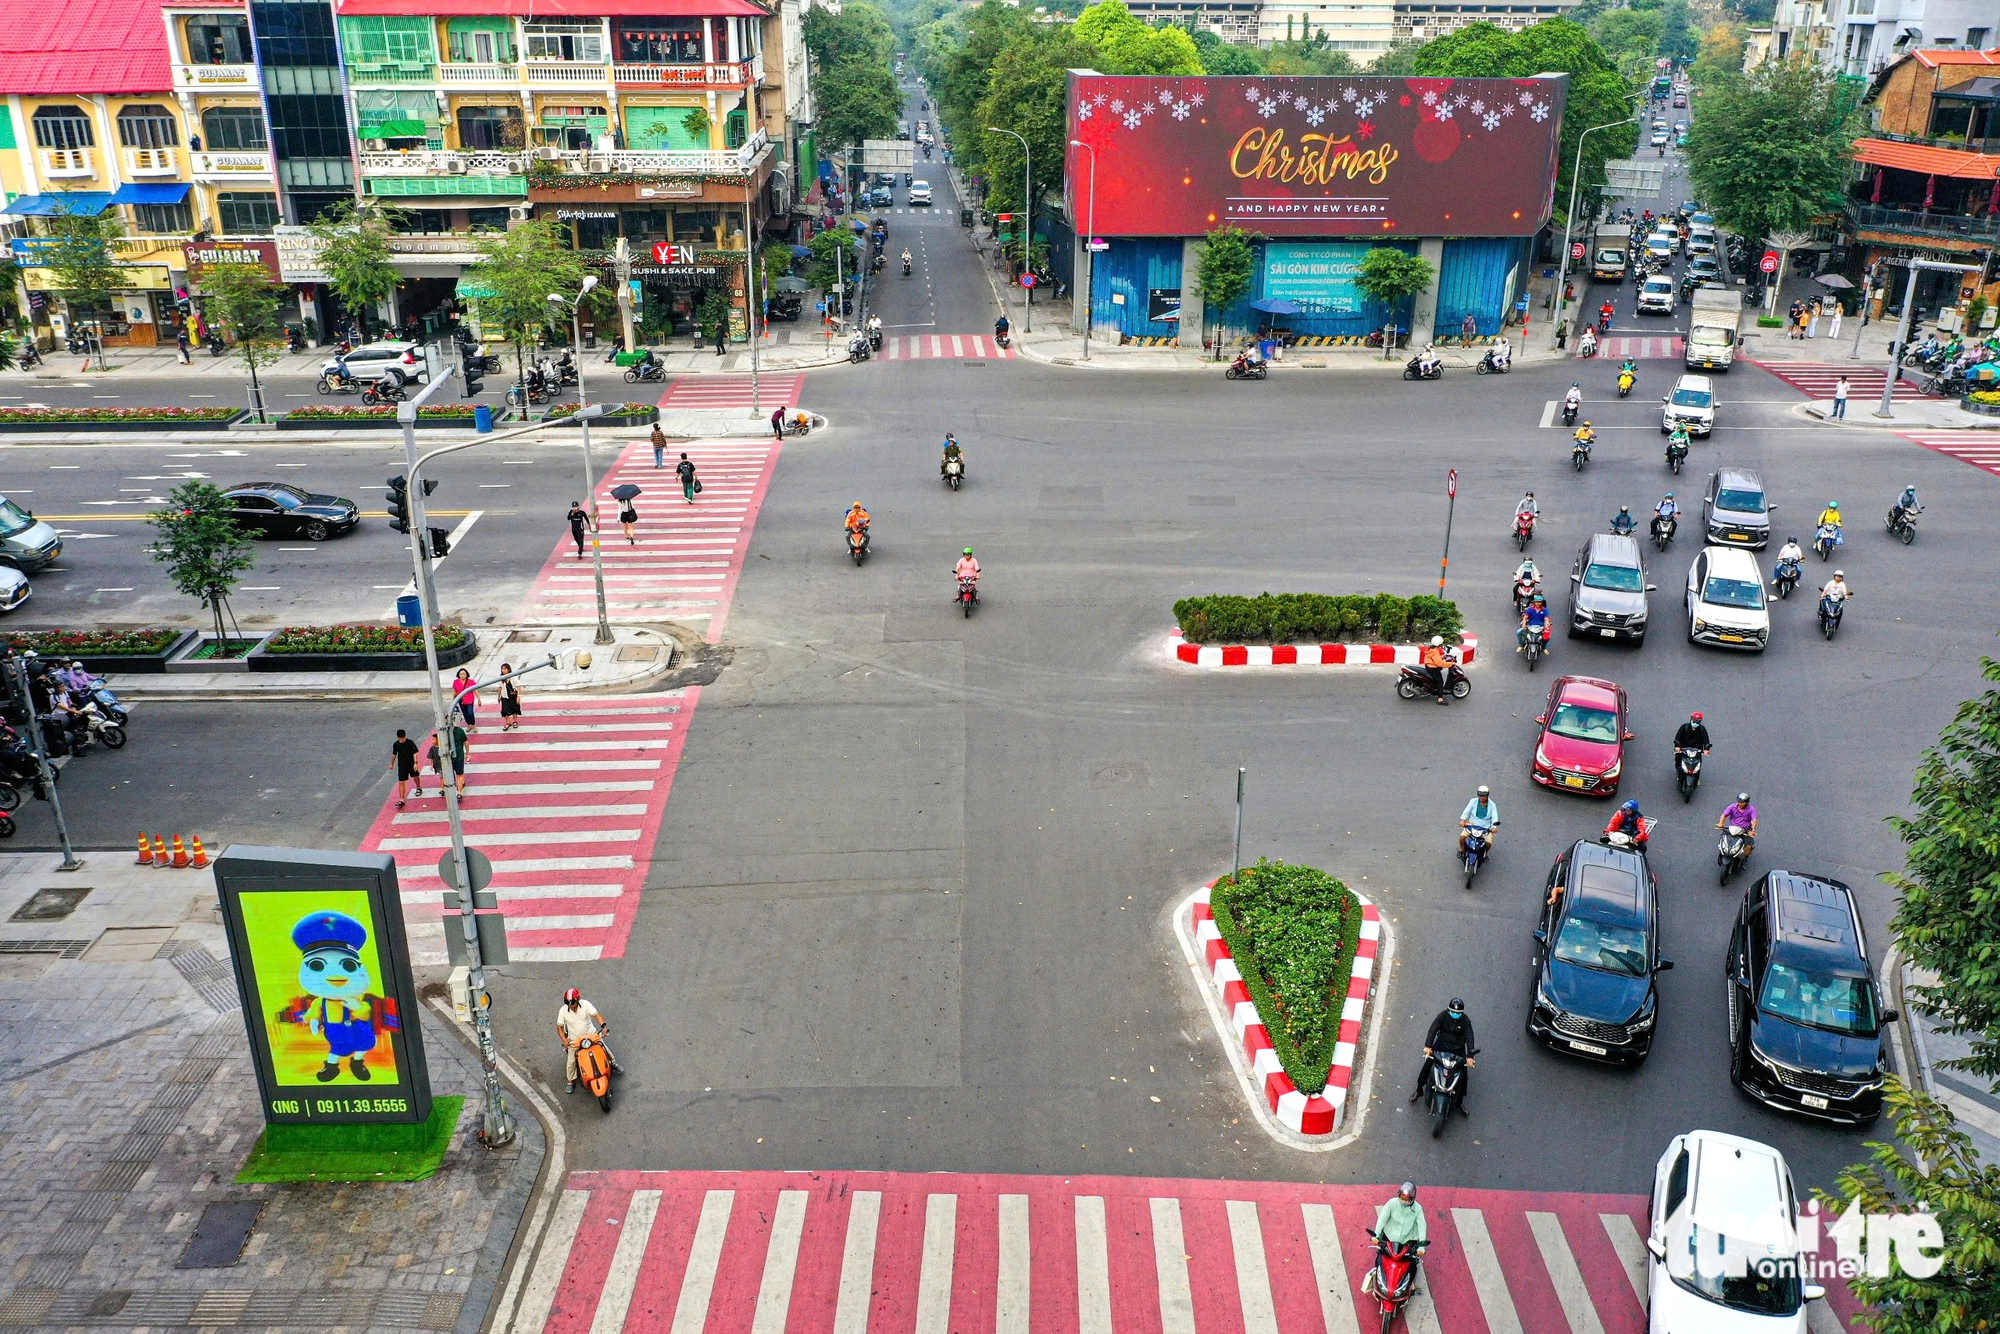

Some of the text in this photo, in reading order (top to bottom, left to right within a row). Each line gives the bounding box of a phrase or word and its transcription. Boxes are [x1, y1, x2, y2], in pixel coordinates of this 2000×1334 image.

[198, 68, 245, 77] GUJARAT
[1230, 127, 1398, 185] Christmas
[216, 157, 263, 166] GUJARAT
[1237, 204, 1377, 213] AND HAPPY NEW YEAR
[278, 239, 308, 250] KING
[199, 249, 261, 264] GUJARAT
[668, 267, 694, 275] SAKE
[696, 267, 716, 275] PUB
[1287, 261, 1309, 275] GÒN
[1310, 263, 1328, 275] KIM
[734, 289, 743, 297] 68
[317, 1099, 407, 1113] 0911.39.5555
